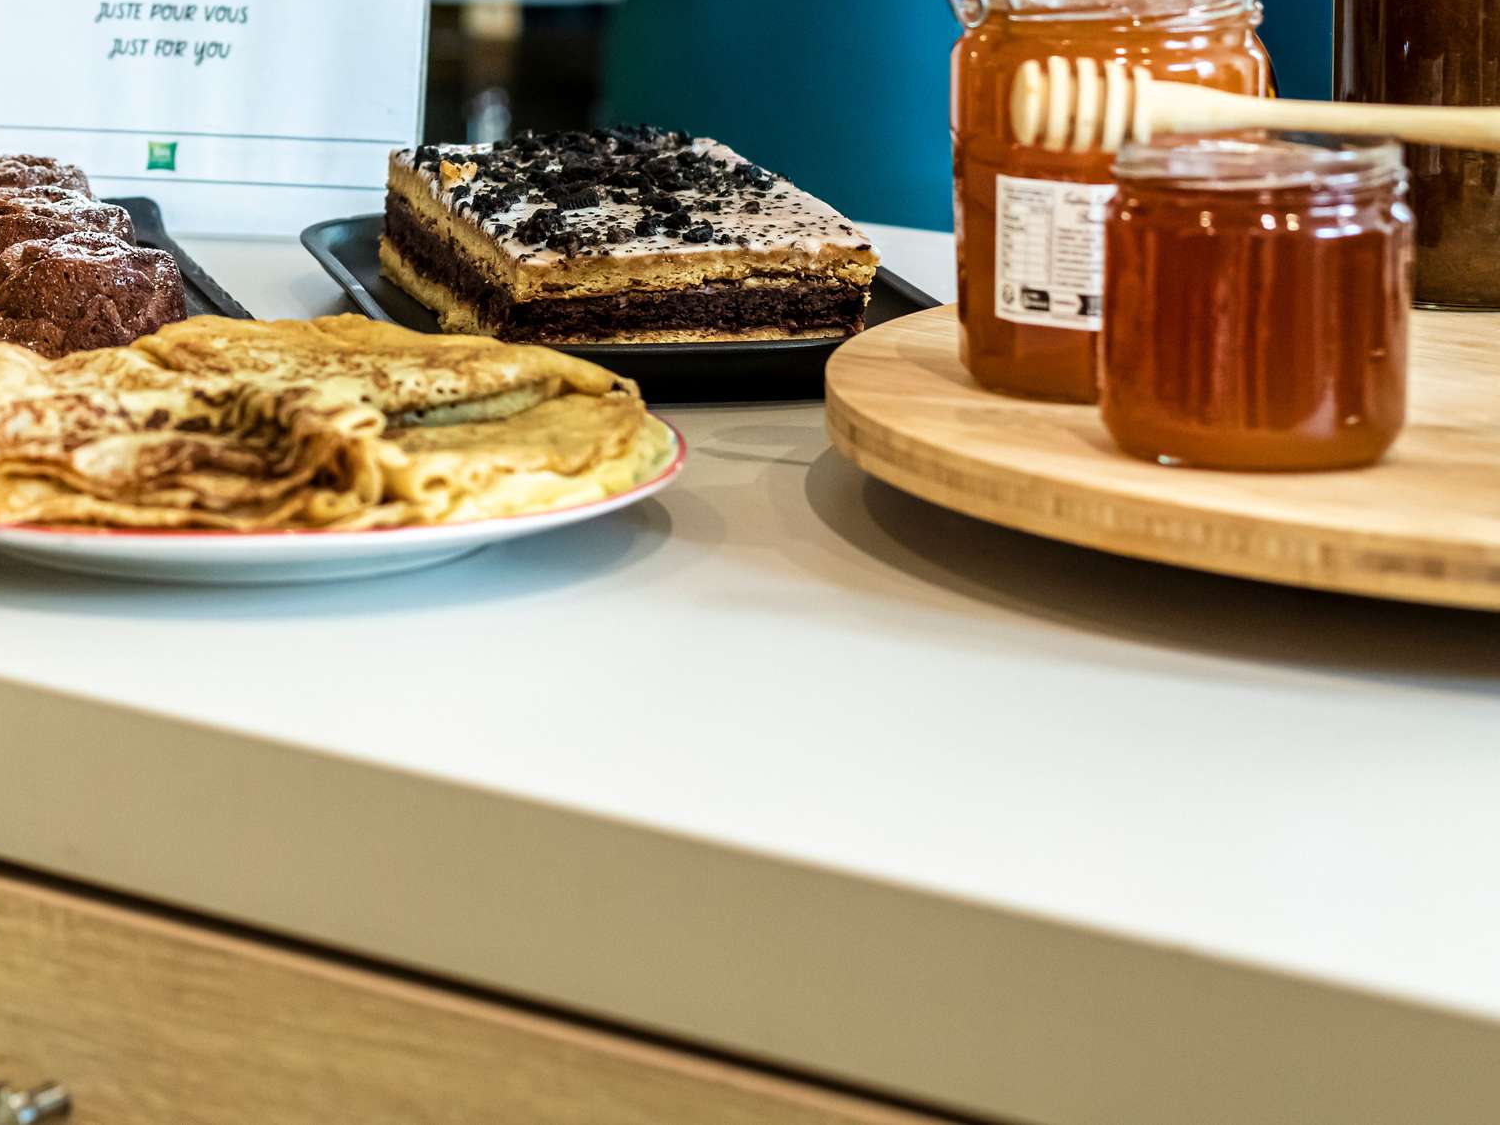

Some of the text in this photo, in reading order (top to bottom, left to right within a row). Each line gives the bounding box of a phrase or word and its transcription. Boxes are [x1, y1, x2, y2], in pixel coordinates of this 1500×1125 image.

[94, 1, 249, 25] JUSTE POUR VOUS
[107, 37, 150, 60] JUST
[153, 38, 189, 58] FOR
